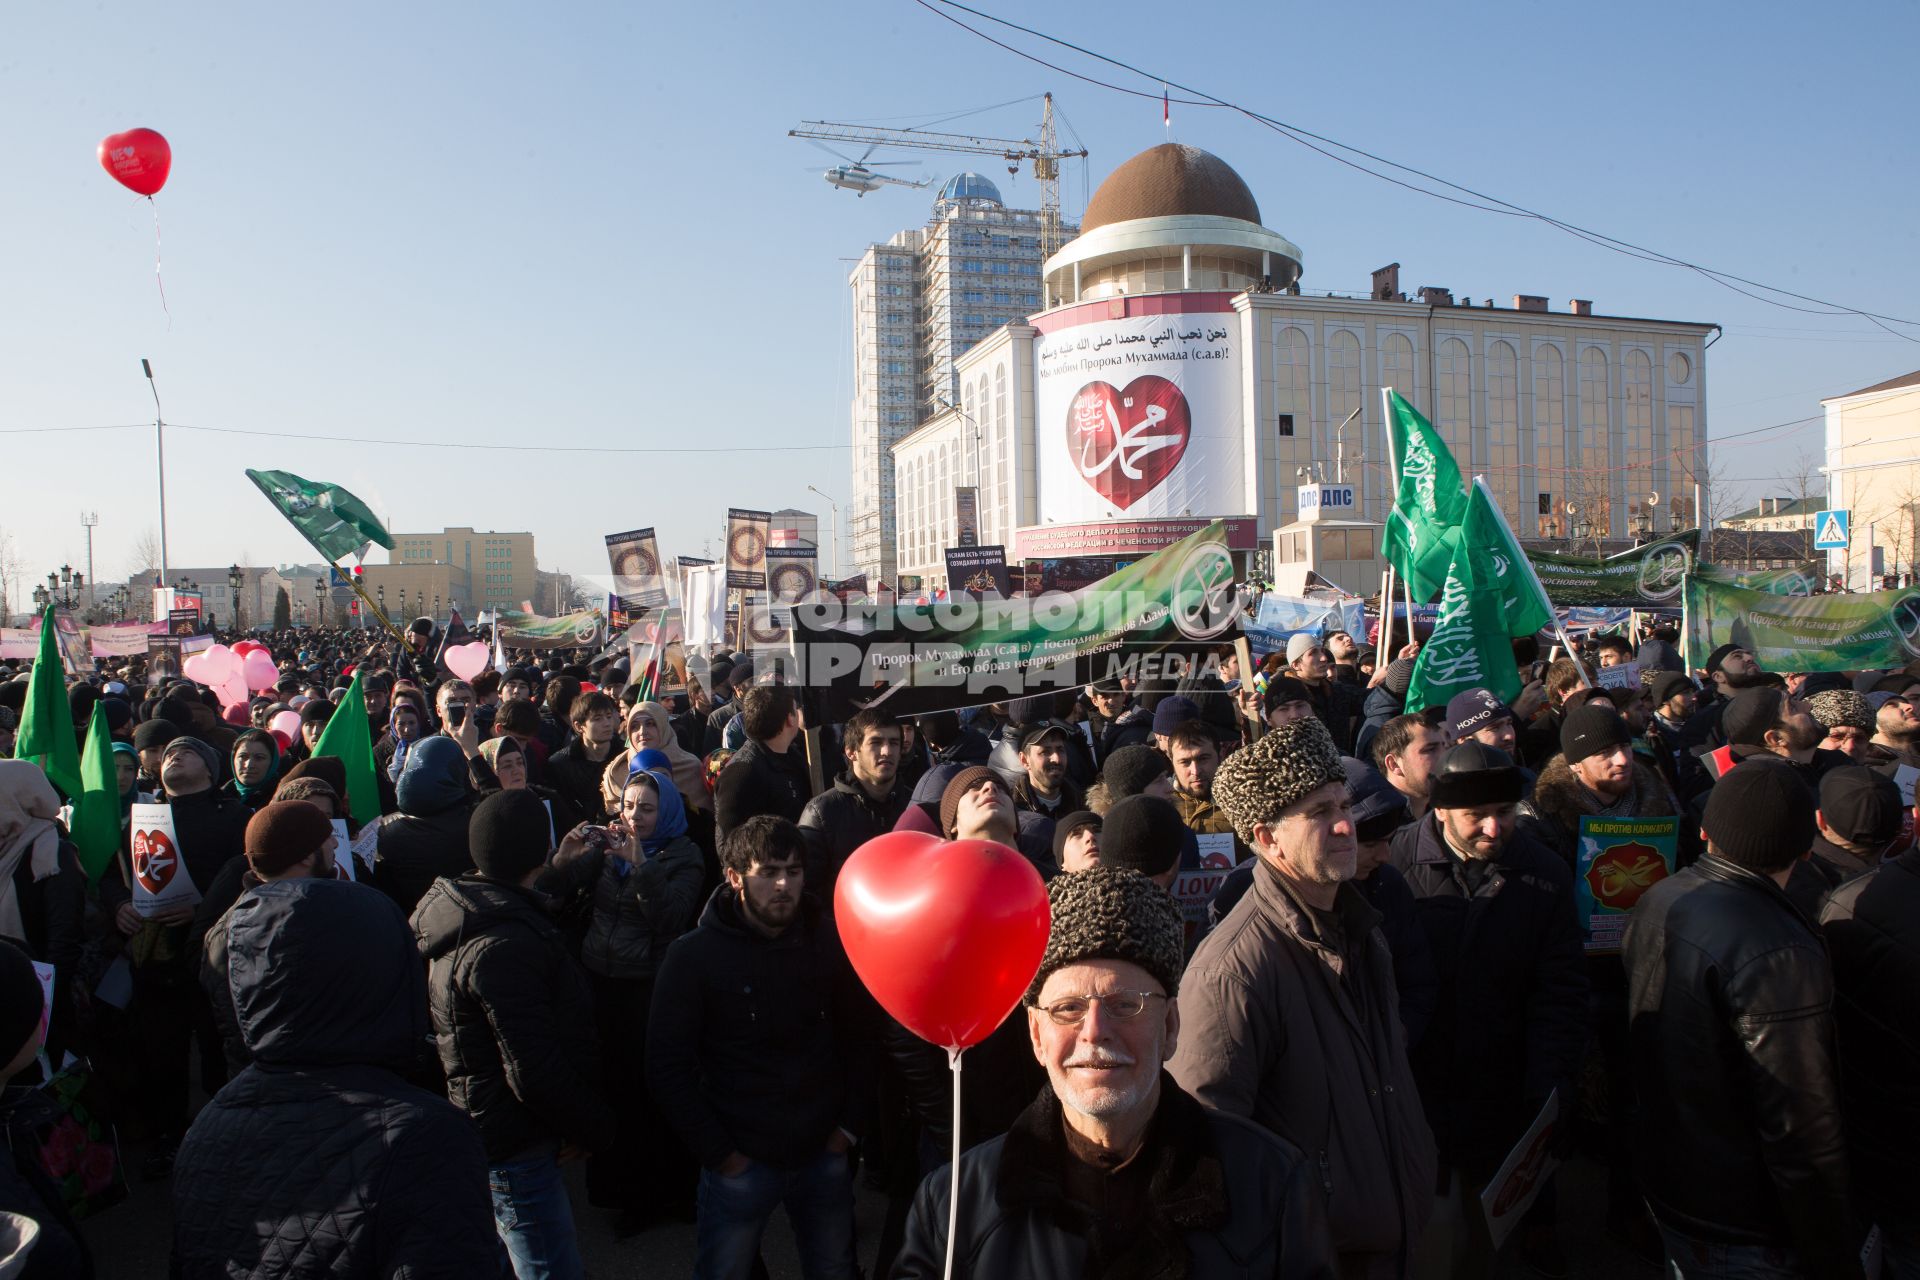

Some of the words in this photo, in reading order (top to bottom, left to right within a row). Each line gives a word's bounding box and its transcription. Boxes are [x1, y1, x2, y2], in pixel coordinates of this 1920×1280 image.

[1150, 329, 1174, 349] النبي
[1178, 328, 1203, 345] نحب
[1207, 328, 1227, 342] نحن
[1076, 338, 1090, 351] الله
[1093, 336, 1113, 351] صلى
[1080, 357, 1122, 372] Пророка
[1125, 350, 1188, 368] Мухаммада
[1300, 490, 1317, 509] ДПС
[1321, 489, 1352, 506] ДПС
[1051, 530, 1084, 540] СУДЕБНОГО
[1086, 526, 1146, 537] ДЕПАРТАМЕНТА
[1066, 540, 1106, 549] ФЕДЕРАЦИИ
[1116, 537, 1164, 546] ЧЕЧЕНСКОЙ
[1538, 577, 1598, 587] косновенен
[872, 651, 921, 668] Пророк
[925, 646, 991, 666] Мухаммад
[994, 640, 1032, 655] (с.а.в)
[1044, 633, 1100, 650] Господин
[1102, 621, 1136, 639] сынов
[1138, 606, 1173, 626] Адама,
[1263, 635, 1289, 648] Аллах
[939, 667, 947, 677] и
[951, 664, 971, 677] Его
[974, 658, 1011, 675] образ
[1014, 637, 1124, 669] неприкосновенен!
[1456, 710, 1491, 731] НОХЧО
[1590, 824, 1603, 833] МЫ
[1604, 824, 1632, 834] ПРОТИВ
